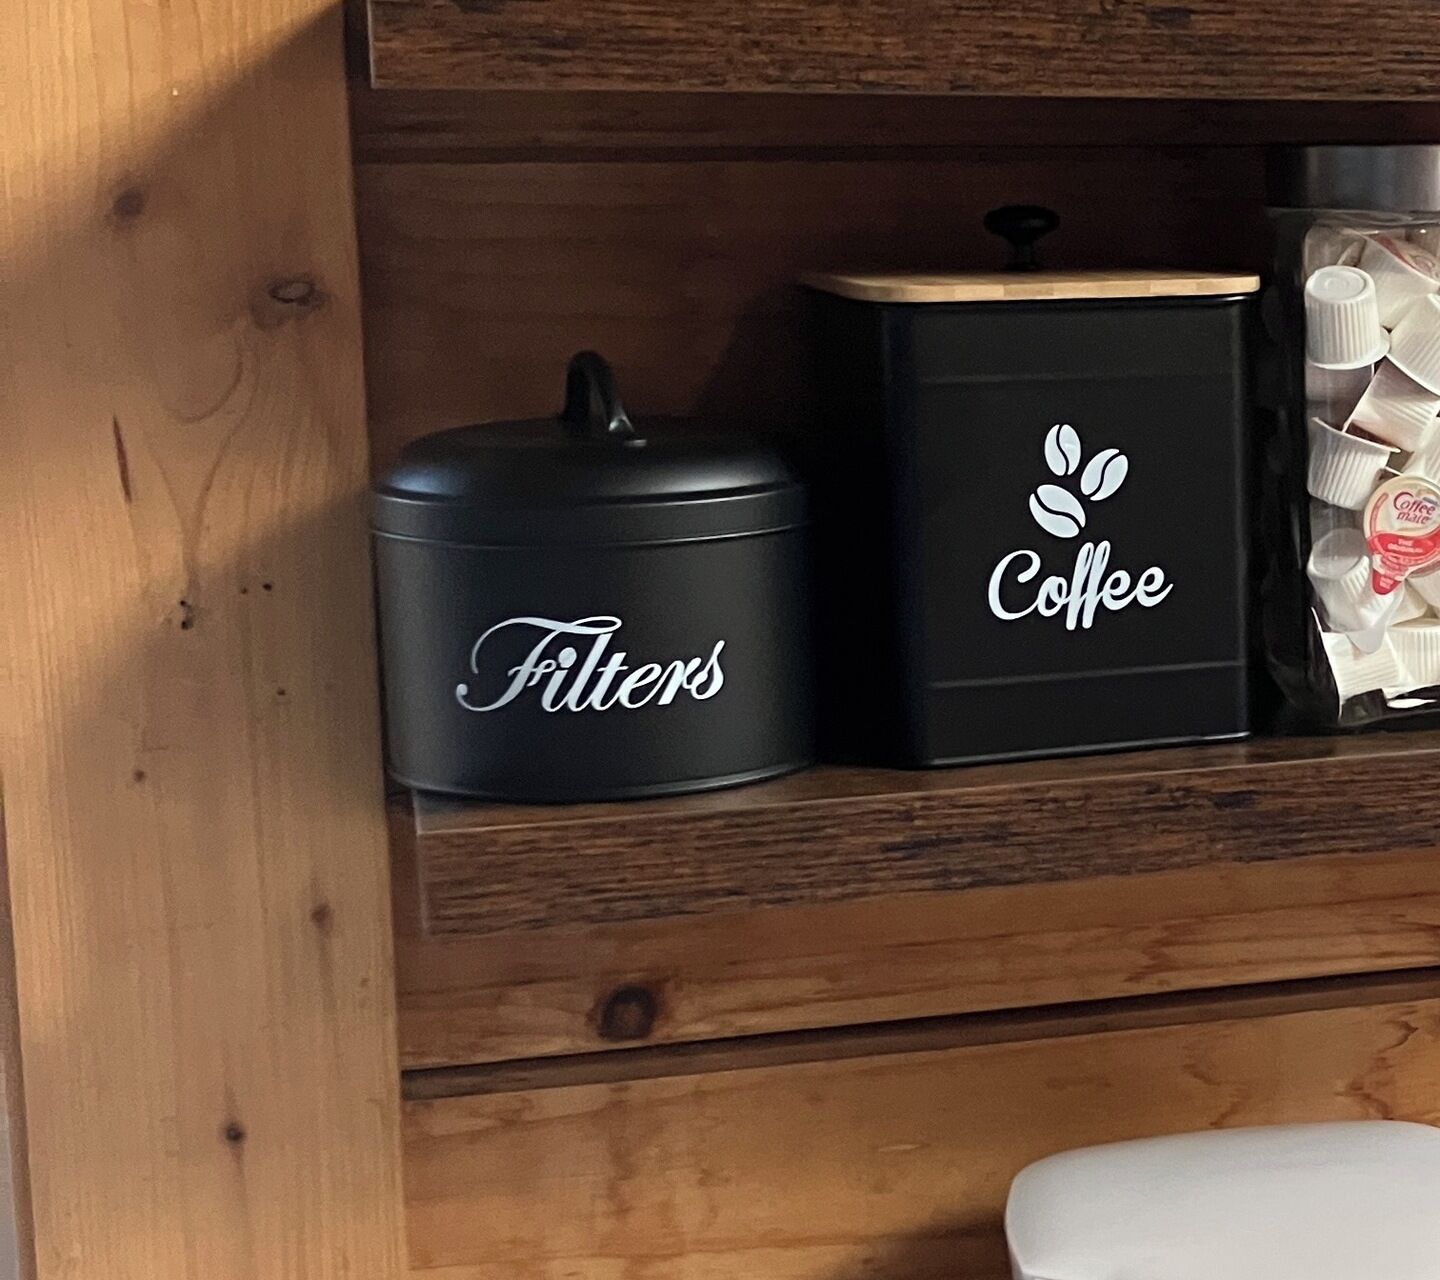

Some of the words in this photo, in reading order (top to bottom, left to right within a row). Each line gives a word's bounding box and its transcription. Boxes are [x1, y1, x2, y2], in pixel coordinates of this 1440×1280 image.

[1393, 491, 1437, 516] Coffee
[987, 539, 1175, 632] Coffee
[455, 615, 728, 714] Filters
